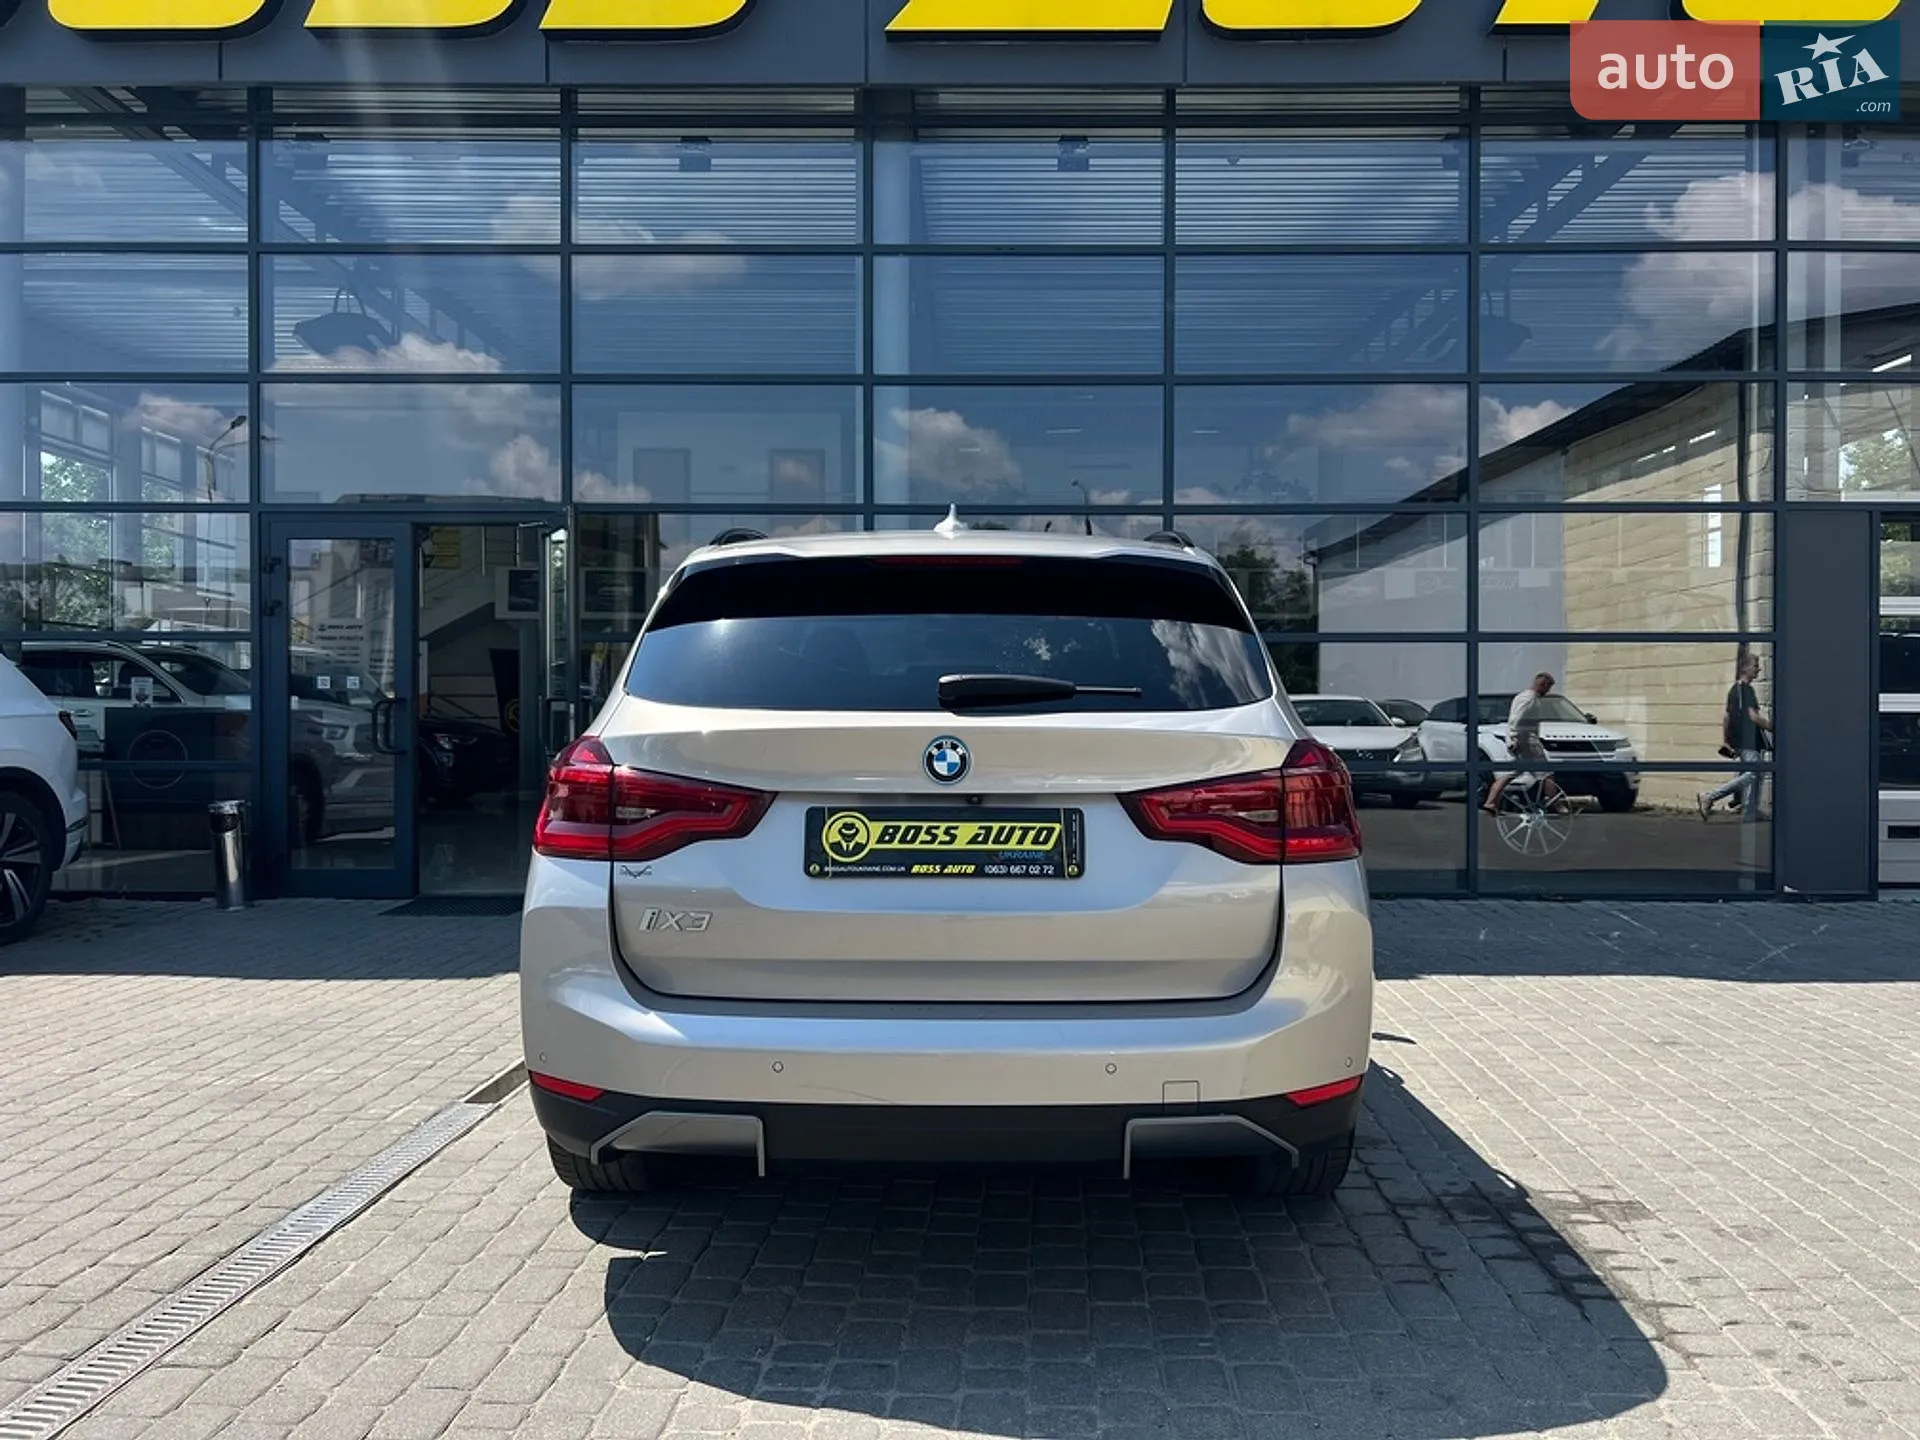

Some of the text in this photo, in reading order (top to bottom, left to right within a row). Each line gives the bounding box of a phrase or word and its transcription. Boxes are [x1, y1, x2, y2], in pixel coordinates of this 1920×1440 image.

[875, 824, 959, 846] BOSS
[966, 824, 1060, 846] AUTO
[910, 864, 941, 875] BOSS
[943, 864, 977, 874] AUTO
[1042, 865, 1055, 875] 72
